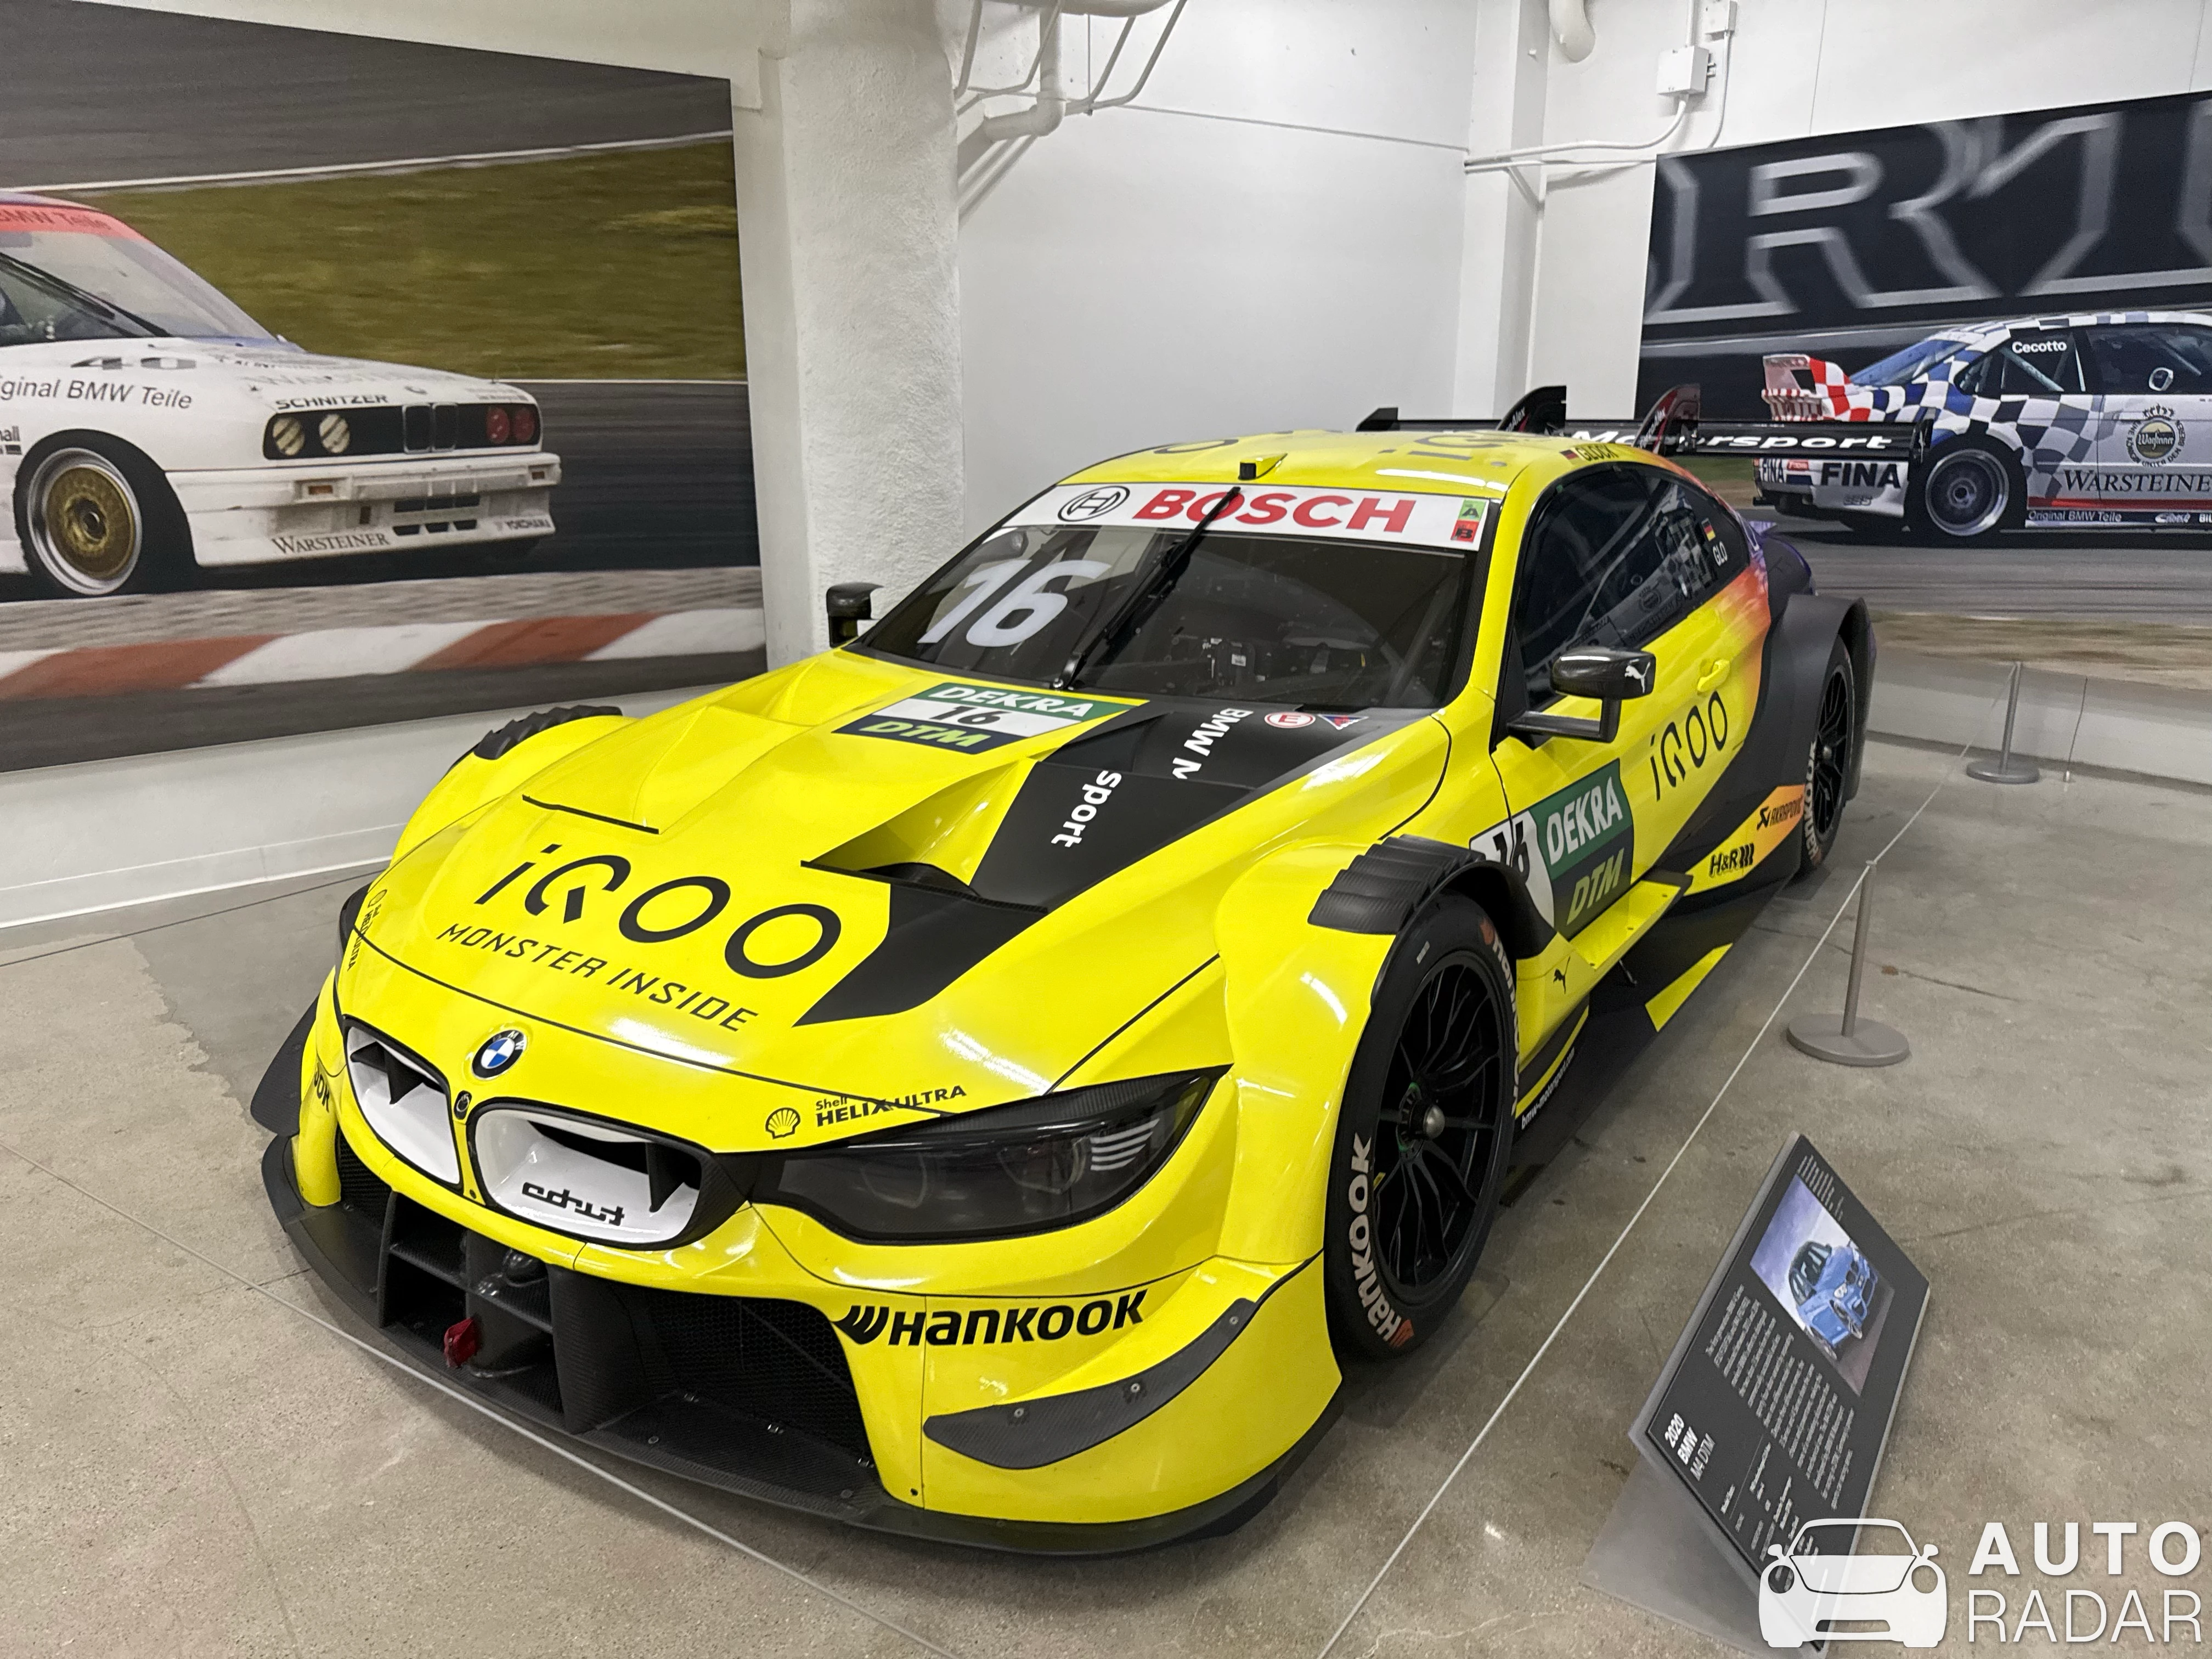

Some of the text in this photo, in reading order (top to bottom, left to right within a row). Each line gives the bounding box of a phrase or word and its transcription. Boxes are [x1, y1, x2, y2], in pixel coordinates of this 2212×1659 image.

[2012, 340, 2068, 354] Cecotto
[0, 375, 192, 409] ginal BMW Teile
[275, 394, 388, 409] SCHNITZER
[1575, 445, 1620, 461] GLOCK
[1762, 458, 1784, 483] FINA
[1820, 461, 1901, 489] FINA
[1133, 488, 1417, 534] BOSCH
[2028, 510, 2122, 522] Original BMW Teile
[273, 533, 390, 555] WARSTEINER
[1712, 541, 1728, 566] GLO
[917, 559, 1111, 647] 16
[927, 686, 1094, 718] DEKRA
[928, 706, 1003, 725] 16
[859, 721, 991, 747] DTM
[1184, 708, 1254, 757] BMW
[1649, 690, 1728, 802] iQOO
[1051, 770, 1122, 848] sport
[1546, 776, 1623, 866] DEKRA
[1566, 847, 1624, 927] DTM
[474, 843, 842, 979] iQOO
[436, 923, 760, 1032] MONSTER INSIDE
[816, 1096, 848, 1111] Shell
[816, 1084, 967, 1127] HELIX ULTRA
[1664, 1412, 1684, 1449] 2020
[1677, 1426, 1698, 1465] BMW
